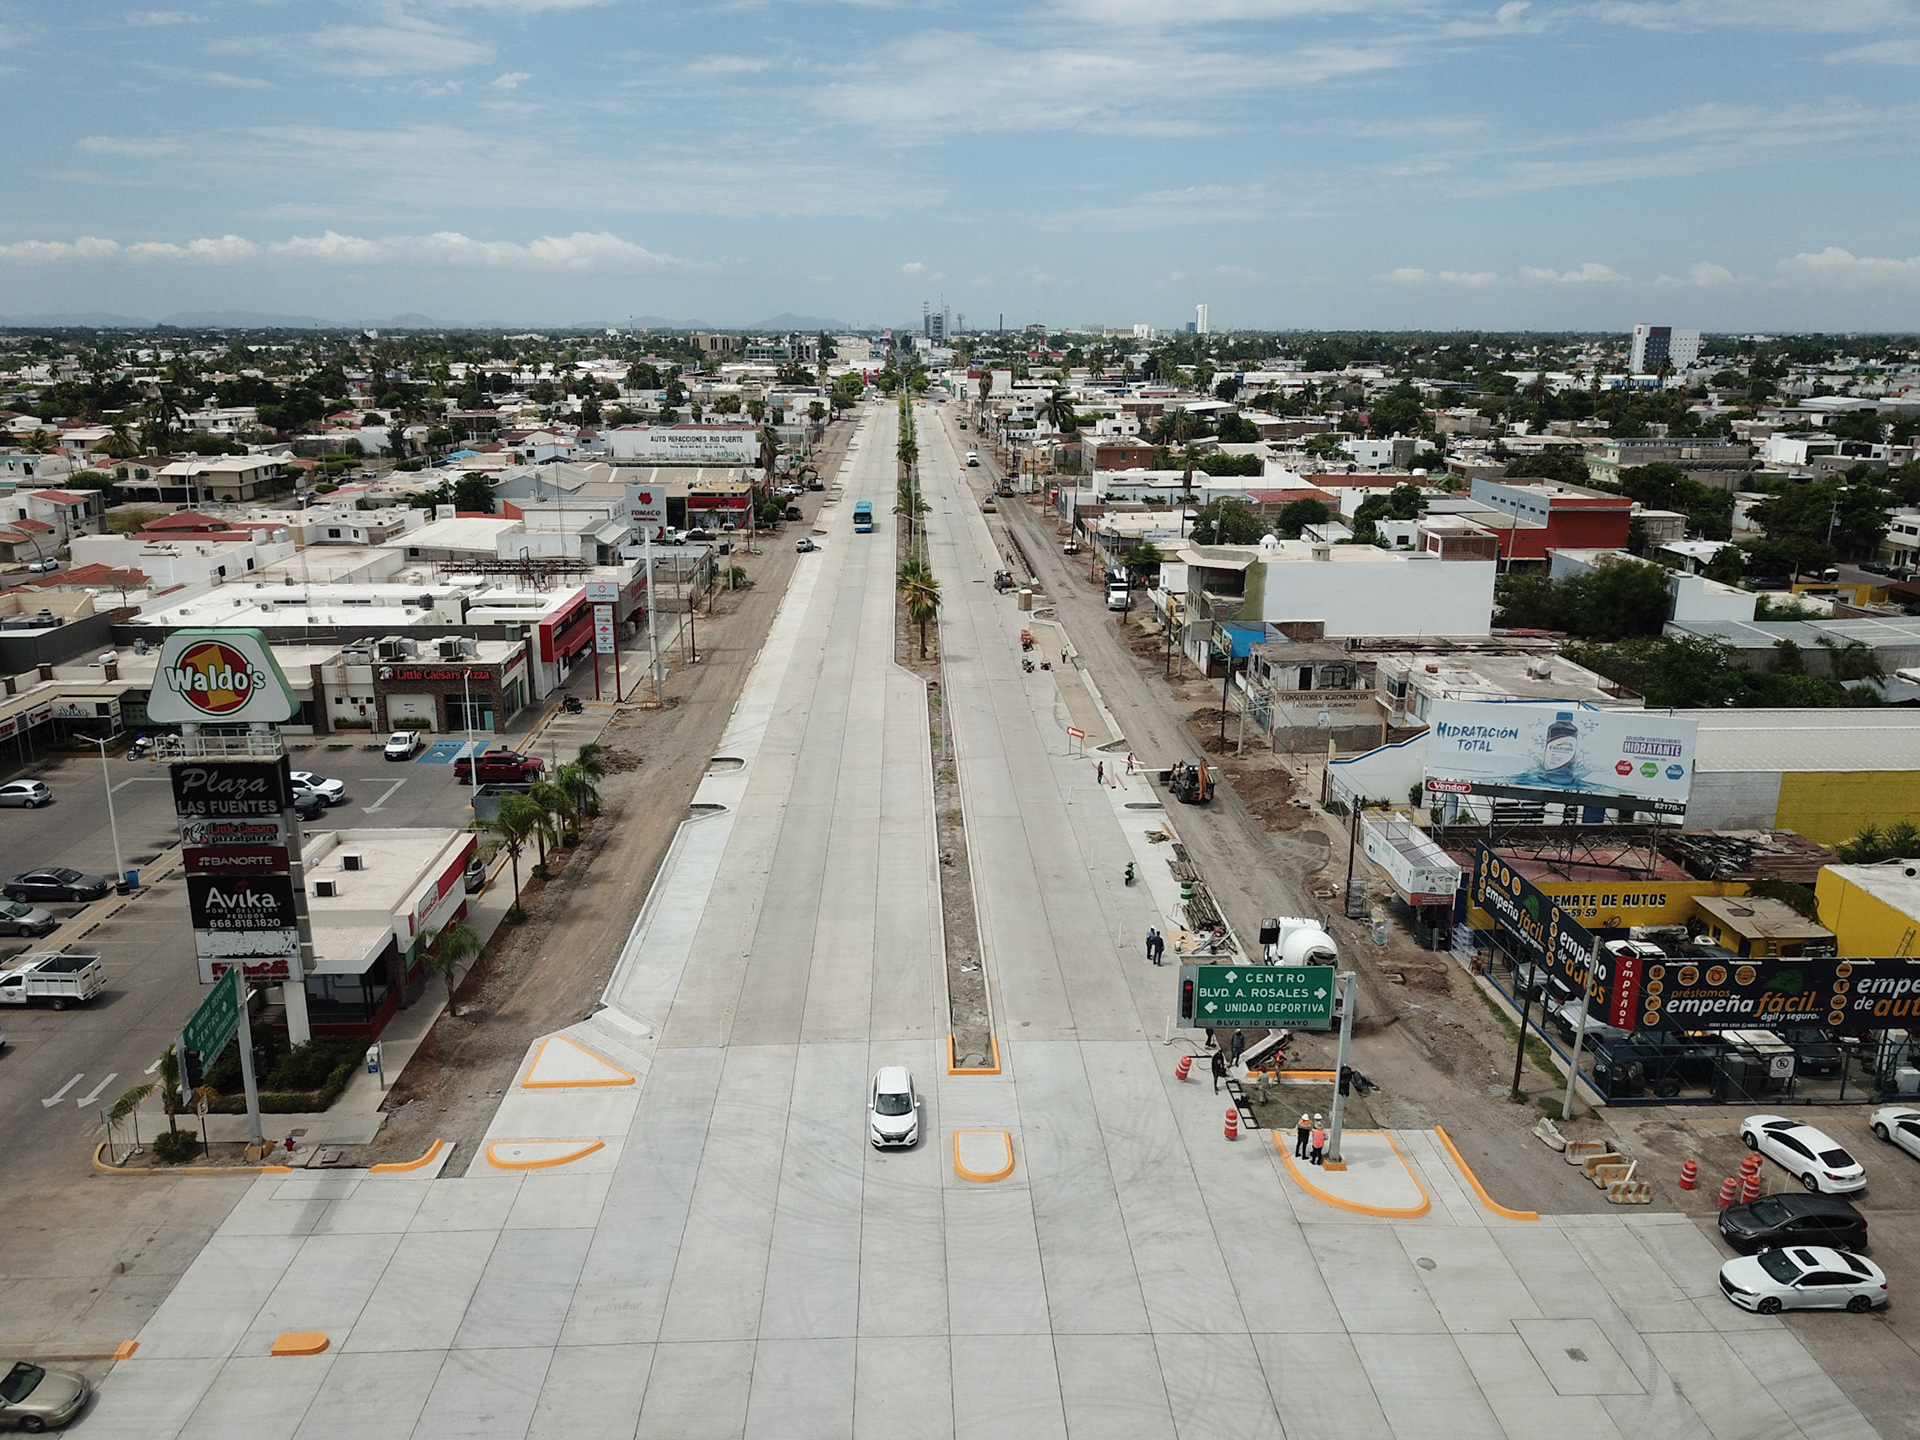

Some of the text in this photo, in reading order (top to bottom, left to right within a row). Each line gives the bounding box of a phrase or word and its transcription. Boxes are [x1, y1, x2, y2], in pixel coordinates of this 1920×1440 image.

[164, 664, 266, 692] Waldo's
[397, 669, 422, 680] Little
[424, 669, 460, 680] Caesars
[1458, 739, 1493, 752] TOTAL
[1624, 742, 1681, 757] HIDRATANTE
[180, 768, 268, 800] Plaza
[1434, 781, 1468, 793] Vendor
[177, 800, 278, 814] LAS FUENTES
[1654, 802, 1685, 812] 82170-1
[210, 822, 276, 834] Little Caesars
[210, 856, 274, 866] BANORTE
[205, 887, 277, 908] Avika
[1485, 886, 1519, 921] empeña
[1601, 894, 1618, 907] DE
[1622, 893, 1667, 907] AUTOS
[210, 918, 281, 928] 668.818.1820
[1557, 949, 1567, 964] de
[1245, 973, 1306, 983] CENTRO
[1199, 988, 1309, 998] BLVD. A. ROSALES
[1618, 960, 1634, 1025] empeños
[1671, 989, 1731, 999] préstamos
[1224, 1003, 1325, 1013] UNIDAD DEPORTIVA
[1666, 995, 1754, 1016] empeña
[1853, 996, 1874, 1010] de
[1761, 1011, 1780, 1022] ágil
[196, 1012, 220, 1046] CENTRO
